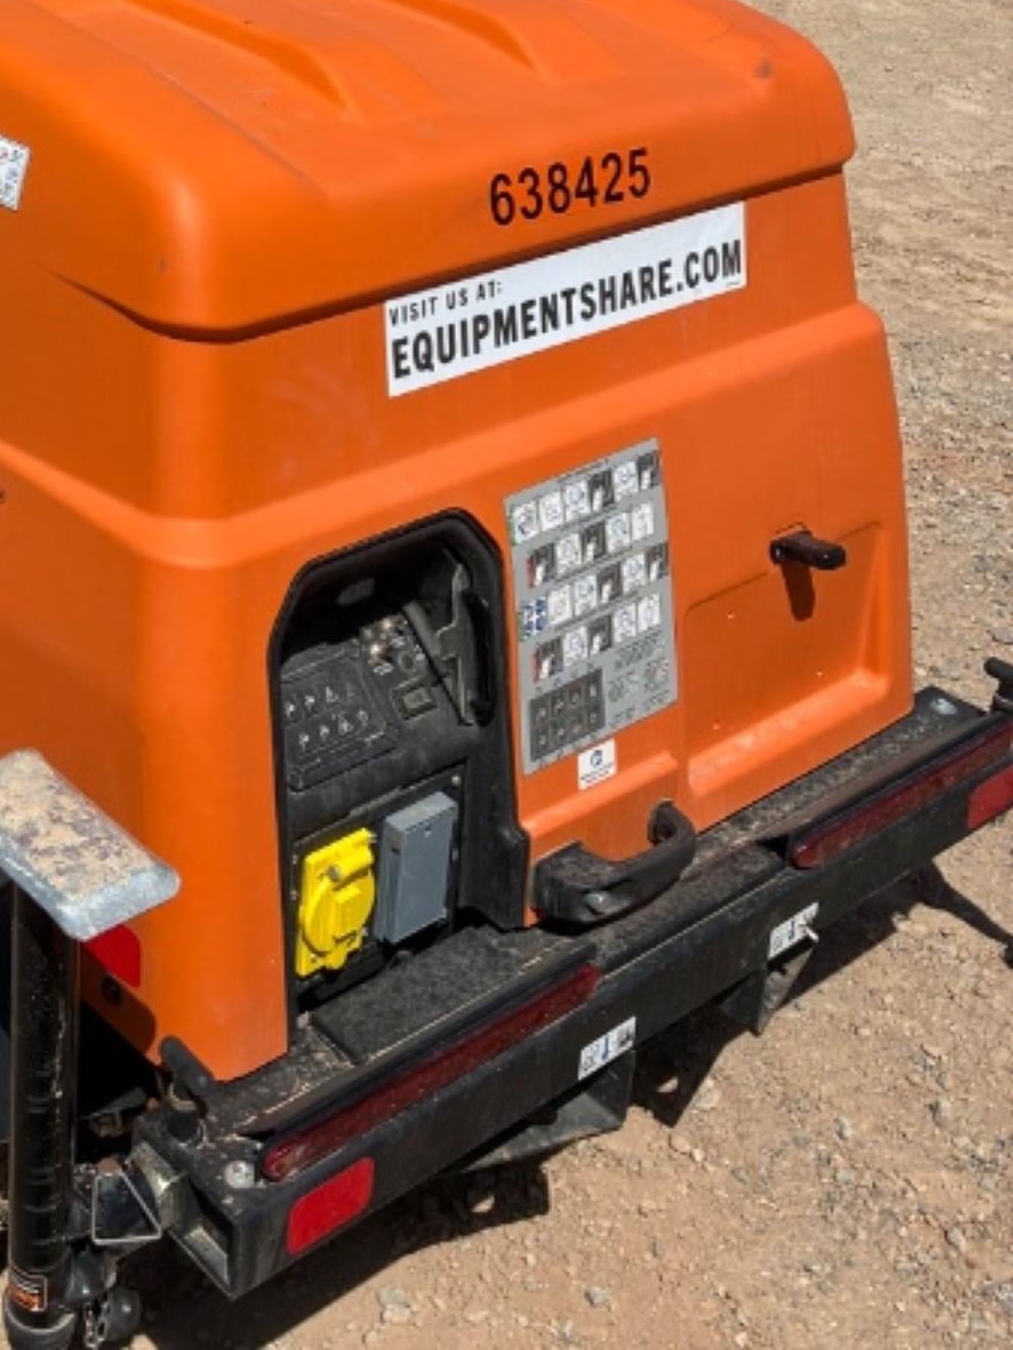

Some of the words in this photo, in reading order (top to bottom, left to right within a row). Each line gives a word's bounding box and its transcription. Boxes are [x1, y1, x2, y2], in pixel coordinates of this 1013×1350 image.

[489, 147, 652, 227] 638425
[389, 295, 438, 327] VISIT
[445, 287, 468, 310] US
[476, 279, 503, 302] AT:
[392, 239, 742, 380] EQUIPMENTSHARE.COM
